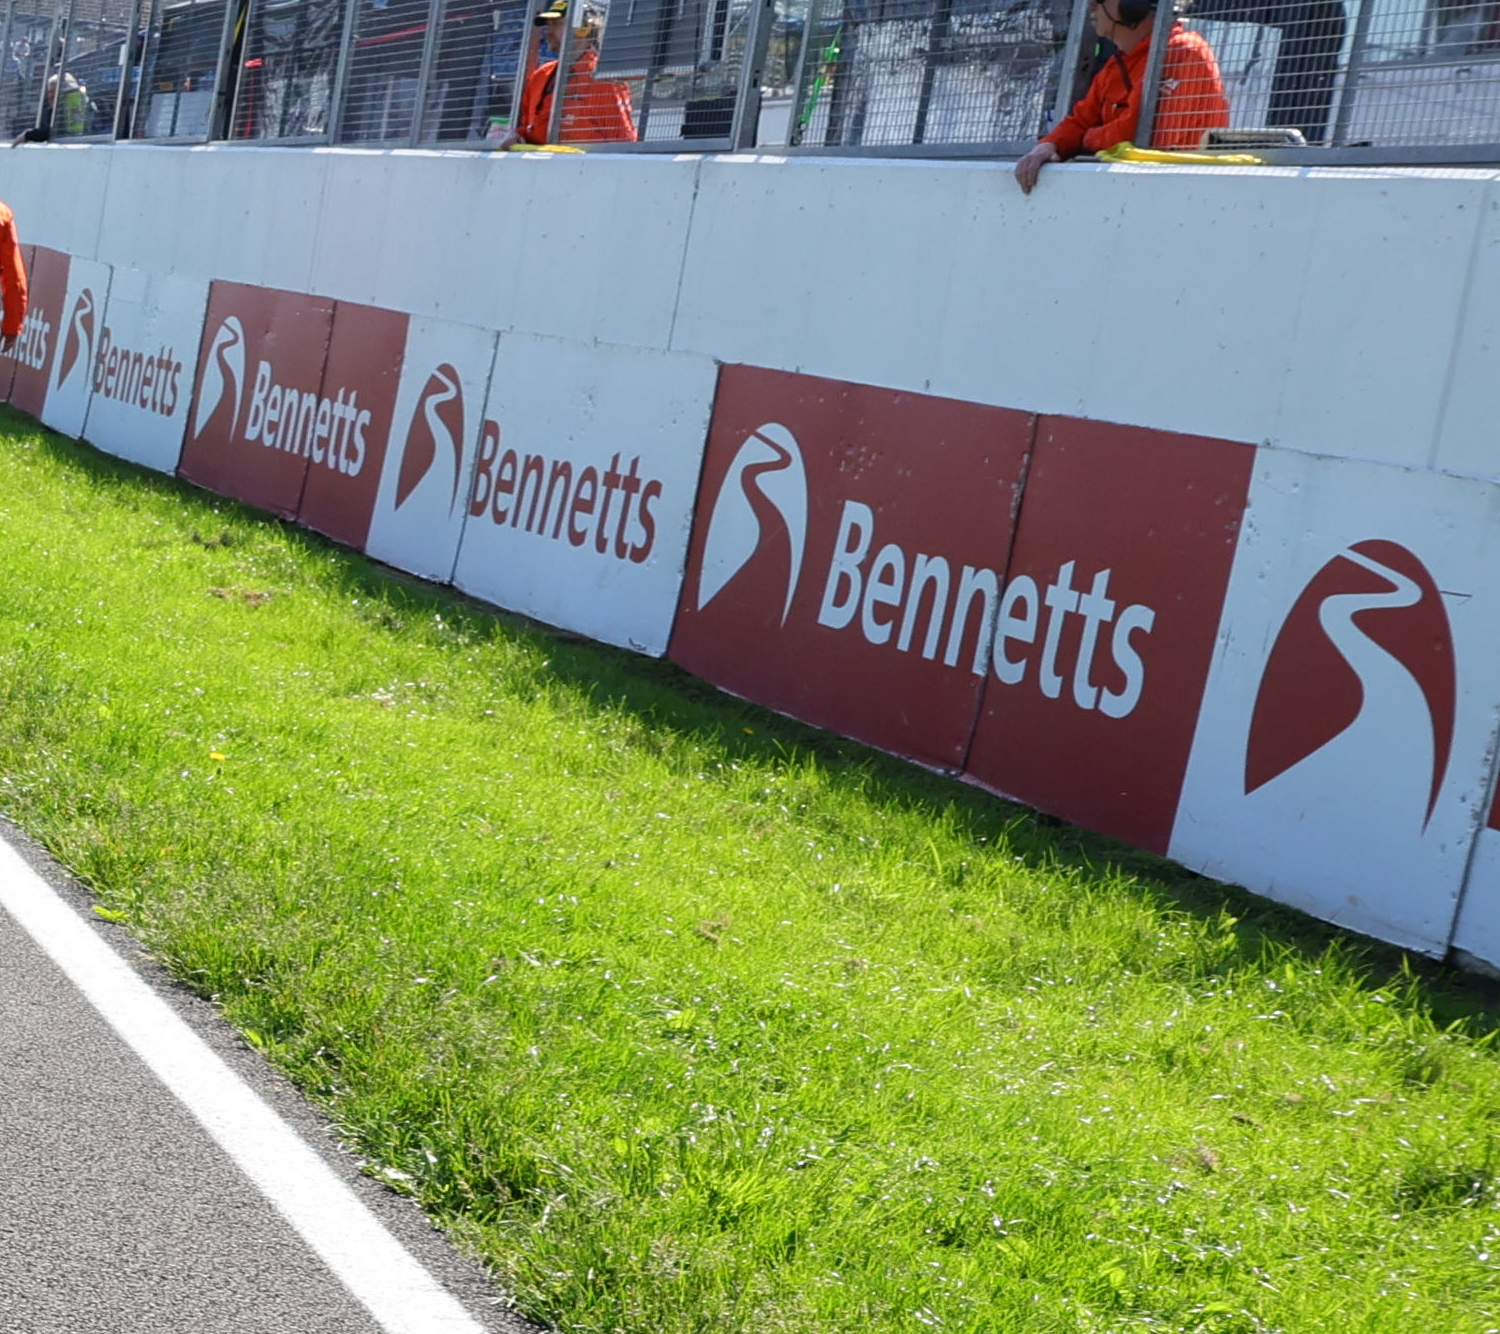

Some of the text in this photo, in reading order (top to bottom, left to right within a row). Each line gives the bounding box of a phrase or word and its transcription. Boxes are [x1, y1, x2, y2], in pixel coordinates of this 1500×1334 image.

[97, 324, 184, 420] Bennetts
[245, 359, 371, 477] Bennetts
[468, 419, 662, 565] Bennetts
[816, 500, 1156, 720] Bennetts
